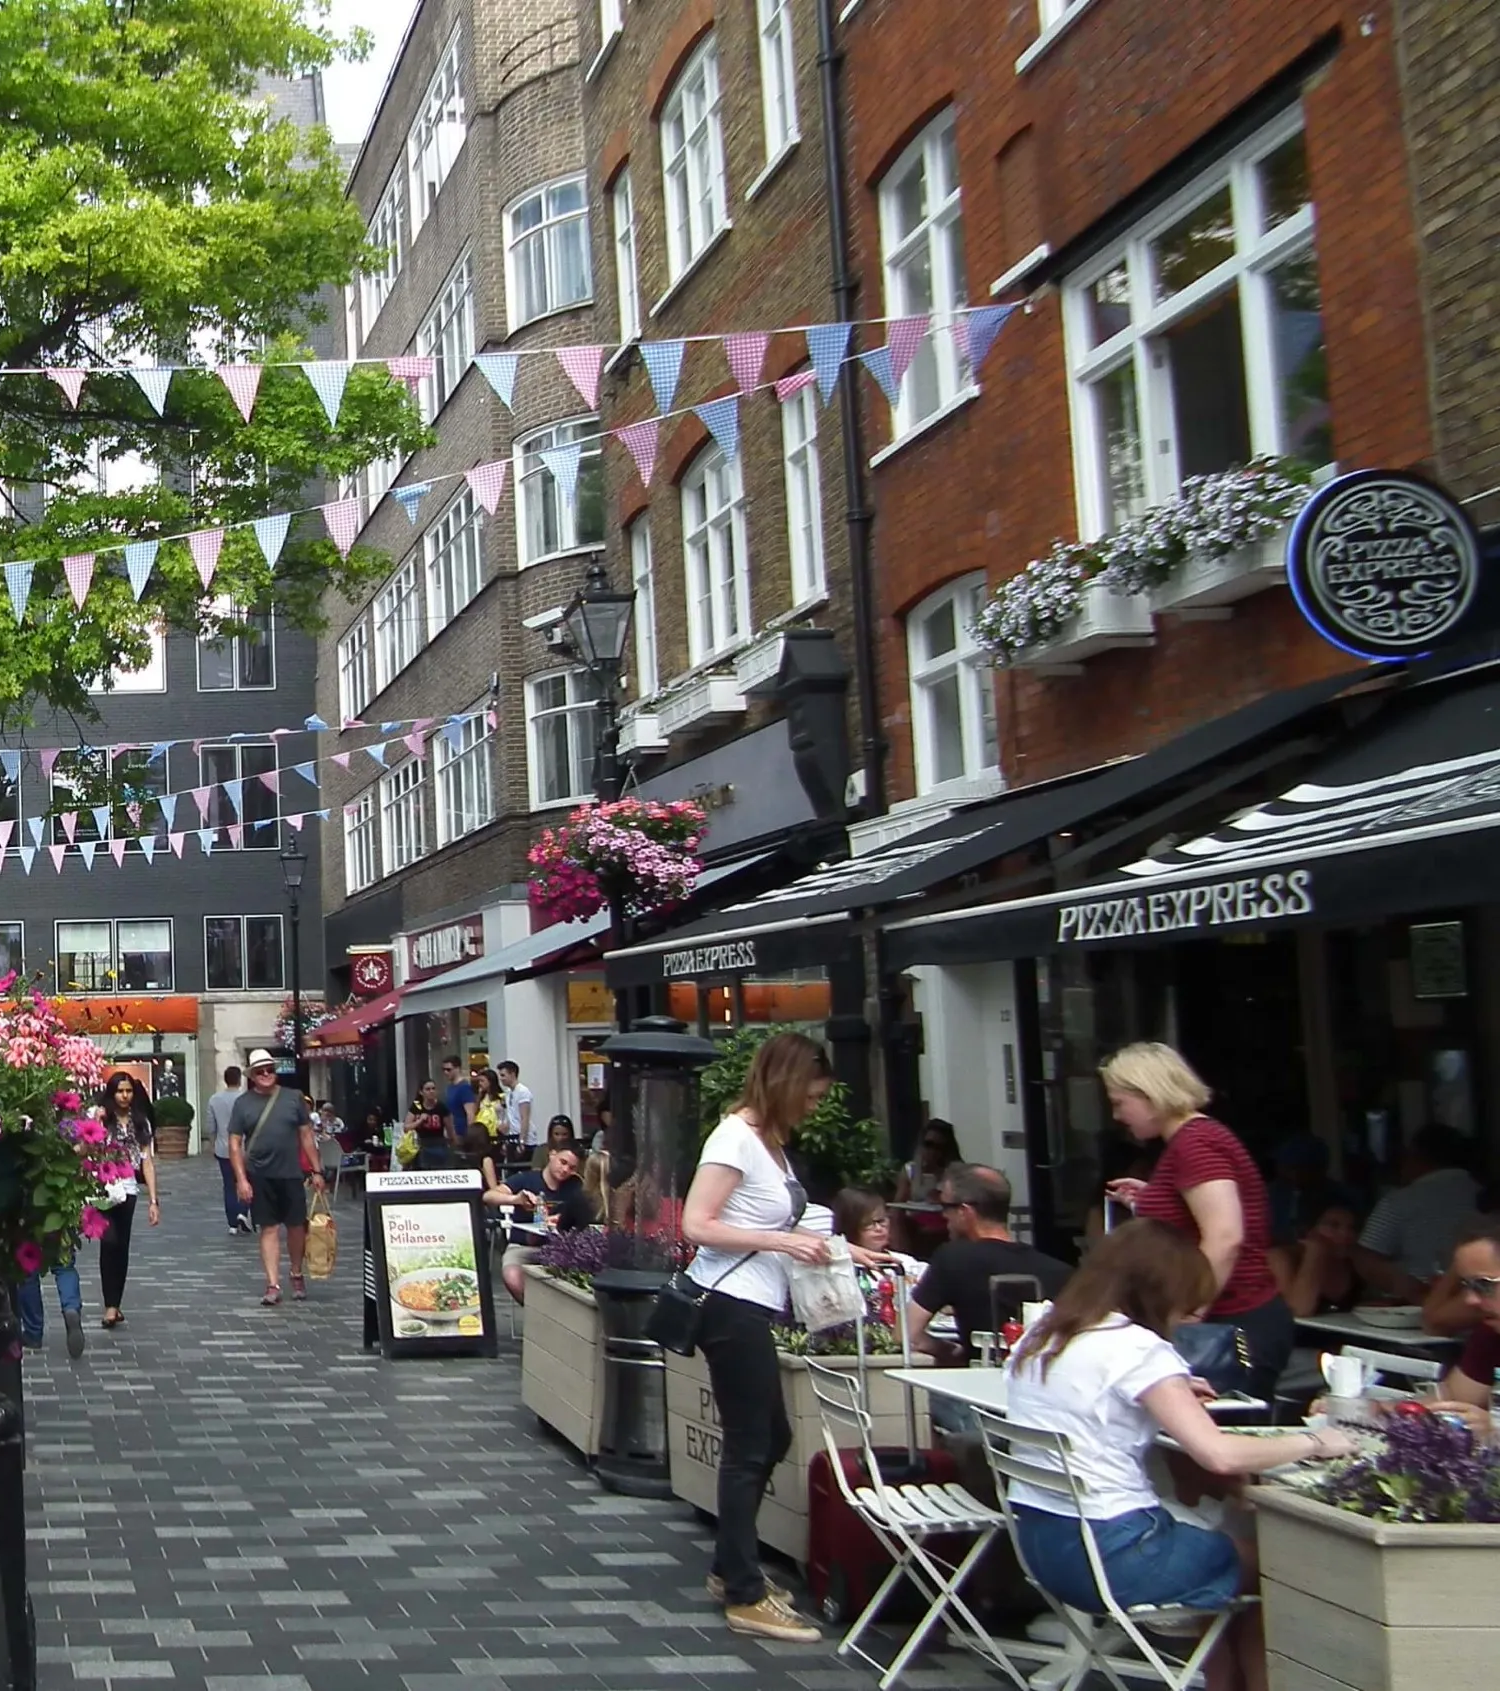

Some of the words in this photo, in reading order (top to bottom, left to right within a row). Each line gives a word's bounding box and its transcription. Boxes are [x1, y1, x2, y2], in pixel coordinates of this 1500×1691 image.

[1346, 536, 1431, 562] PIZZA
[1326, 554, 1459, 585] EXPRESS
[388, 1219, 421, 1231] Pollo
[390, 1233, 446, 1245] Milanese
